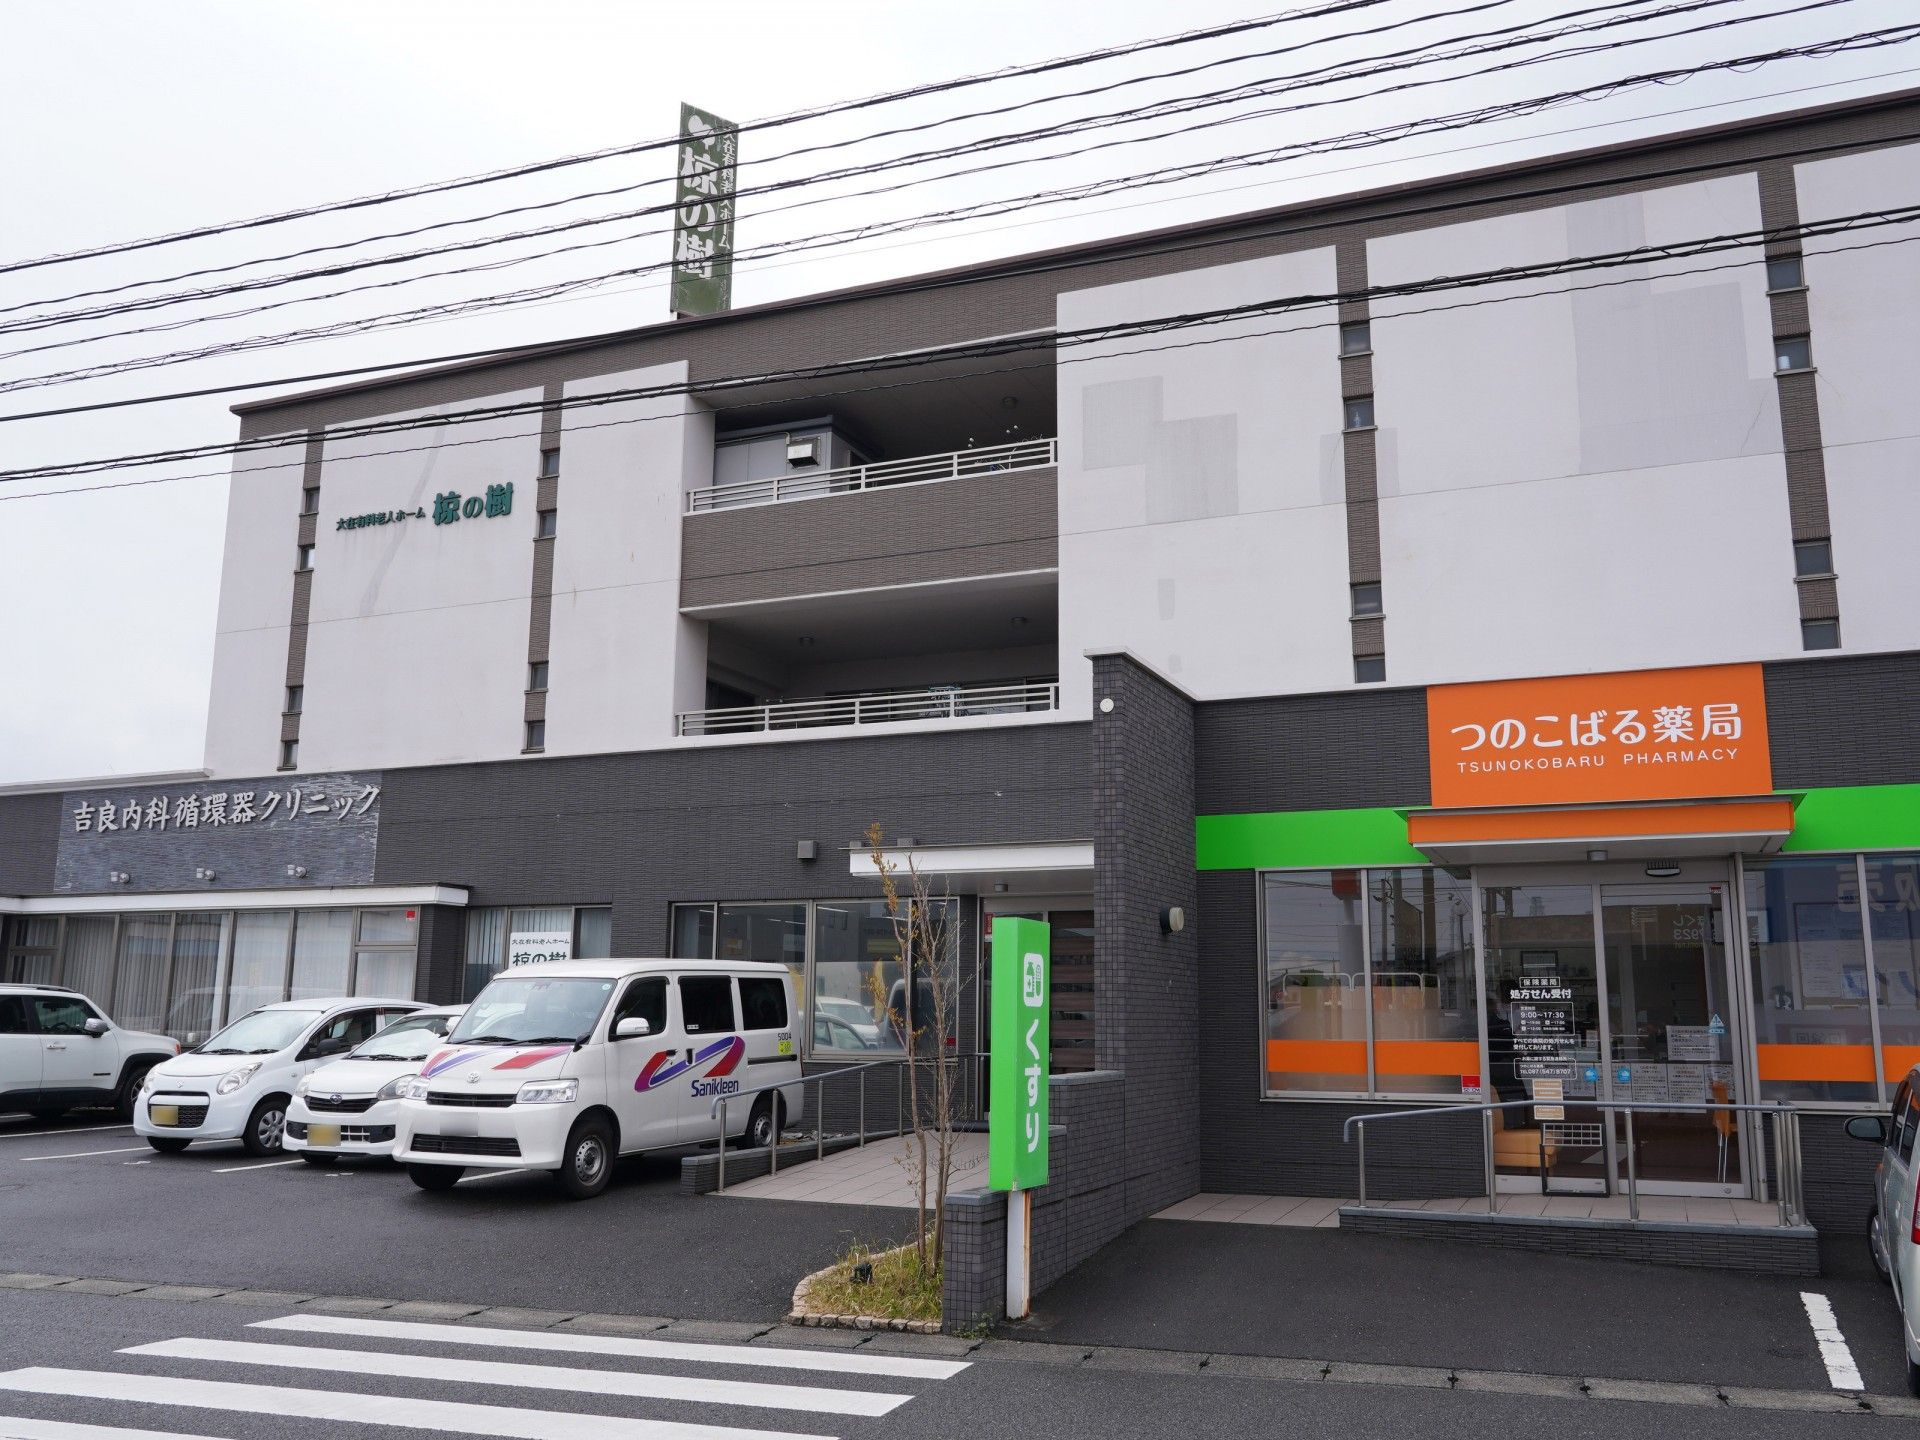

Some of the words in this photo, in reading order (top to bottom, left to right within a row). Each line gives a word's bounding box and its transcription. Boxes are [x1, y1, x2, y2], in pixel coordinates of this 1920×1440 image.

[676, 147, 719, 280] 椋の樹
[432, 481, 513, 526] 椋の樹
[1451, 703, 1742, 751] つのこばる薬局
[1457, 755, 1605, 774] TSUNOKOBARU
[1623, 748, 1738, 765] PHARMACY
[72, 785, 382, 833] 吉良内科循環器クリニック
[1510, 989, 1572, 999] 処方せん受付
[691, 1078, 739, 1097] Sanikleen
[1024, 1018, 1042, 1153] くすり
